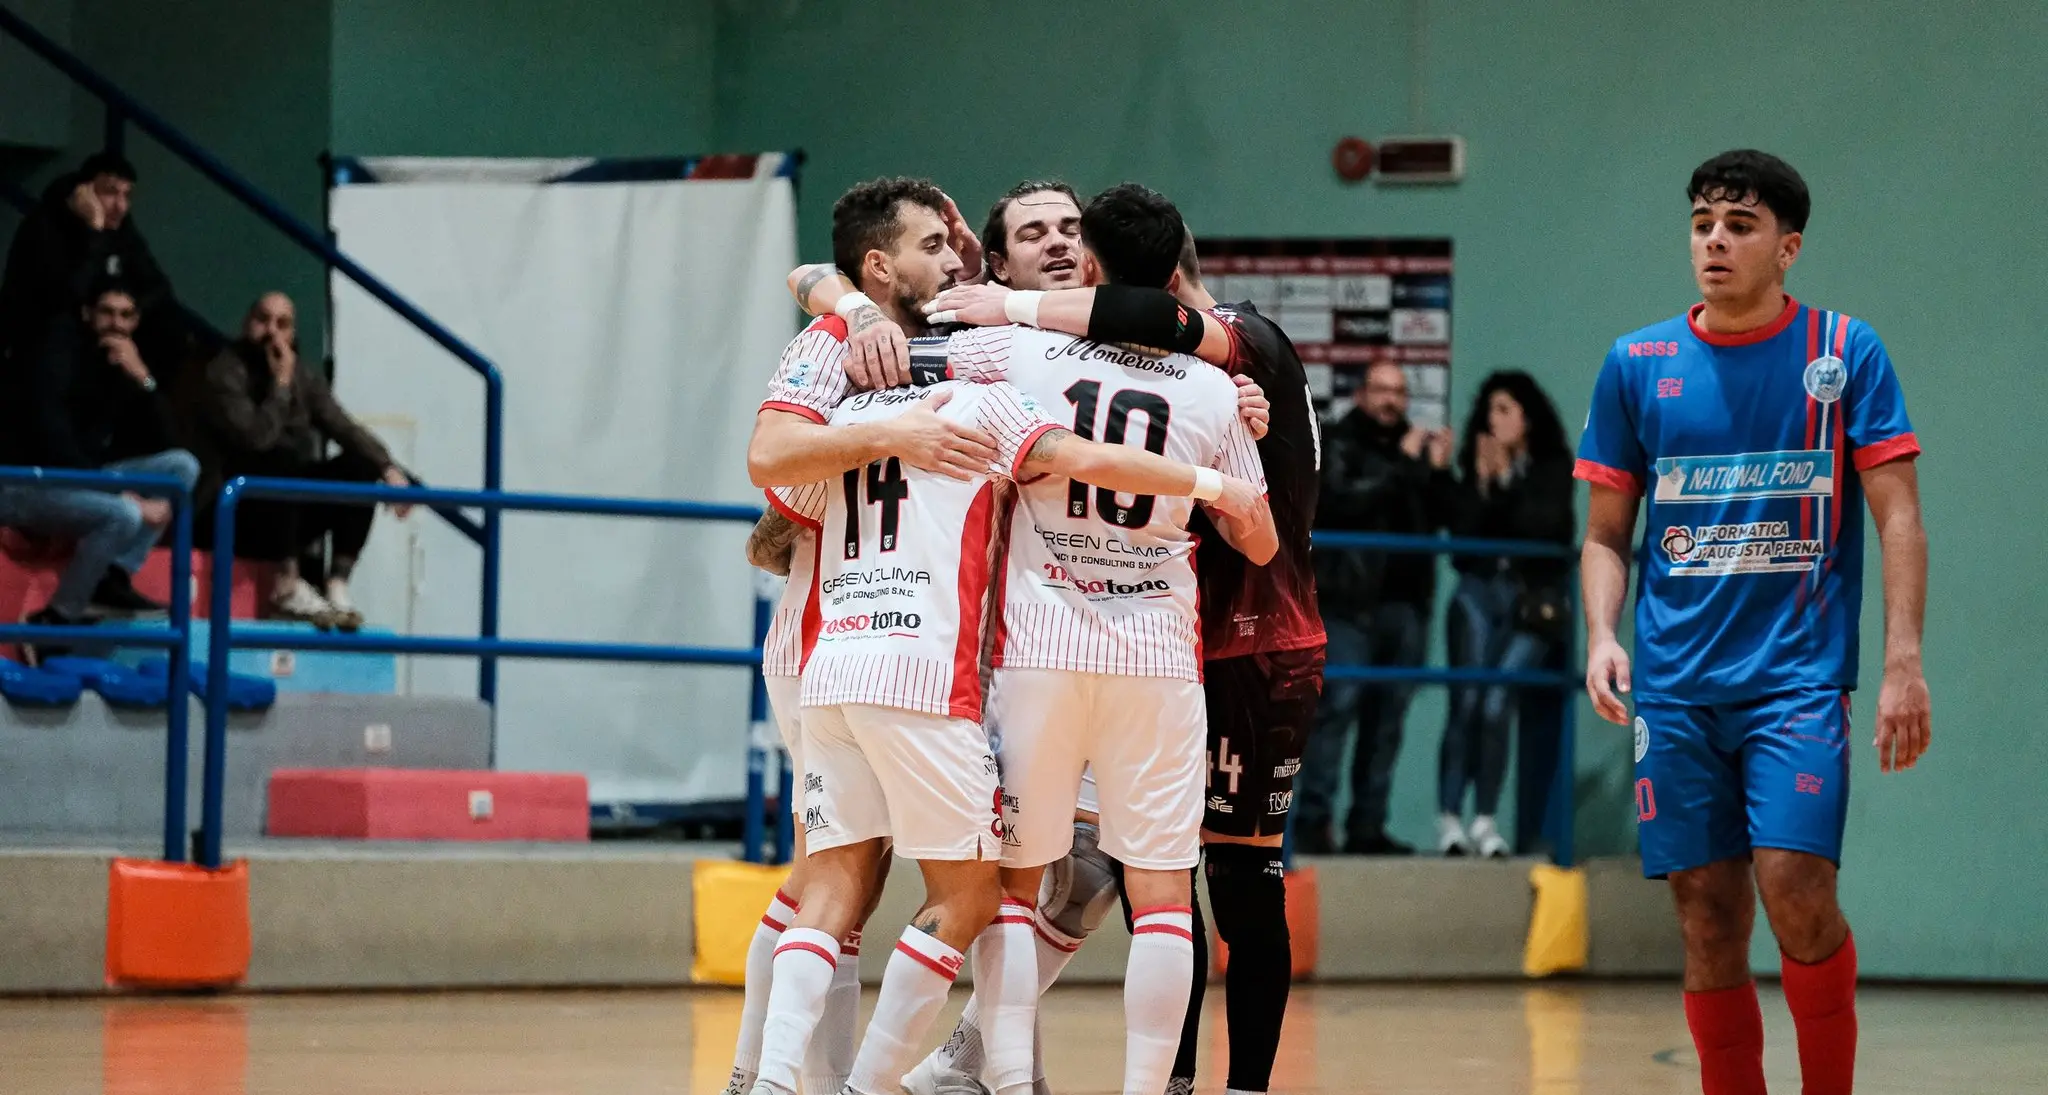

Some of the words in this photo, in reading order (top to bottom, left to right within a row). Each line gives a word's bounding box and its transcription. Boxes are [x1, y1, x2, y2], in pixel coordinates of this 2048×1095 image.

[1045, 338, 1187, 380] Monterosso
[1629, 341, 1679, 358] NSSS
[1063, 378, 1171, 530] 10
[1688, 463, 1769, 490] NATIONAL
[1769, 461, 1815, 485] FOND
[843, 455, 908, 561] 14
[1696, 523, 1789, 541] INFORMATICA
[1774, 541, 1824, 556] PERNA
[1080, 556, 1136, 569] CONSULTING
